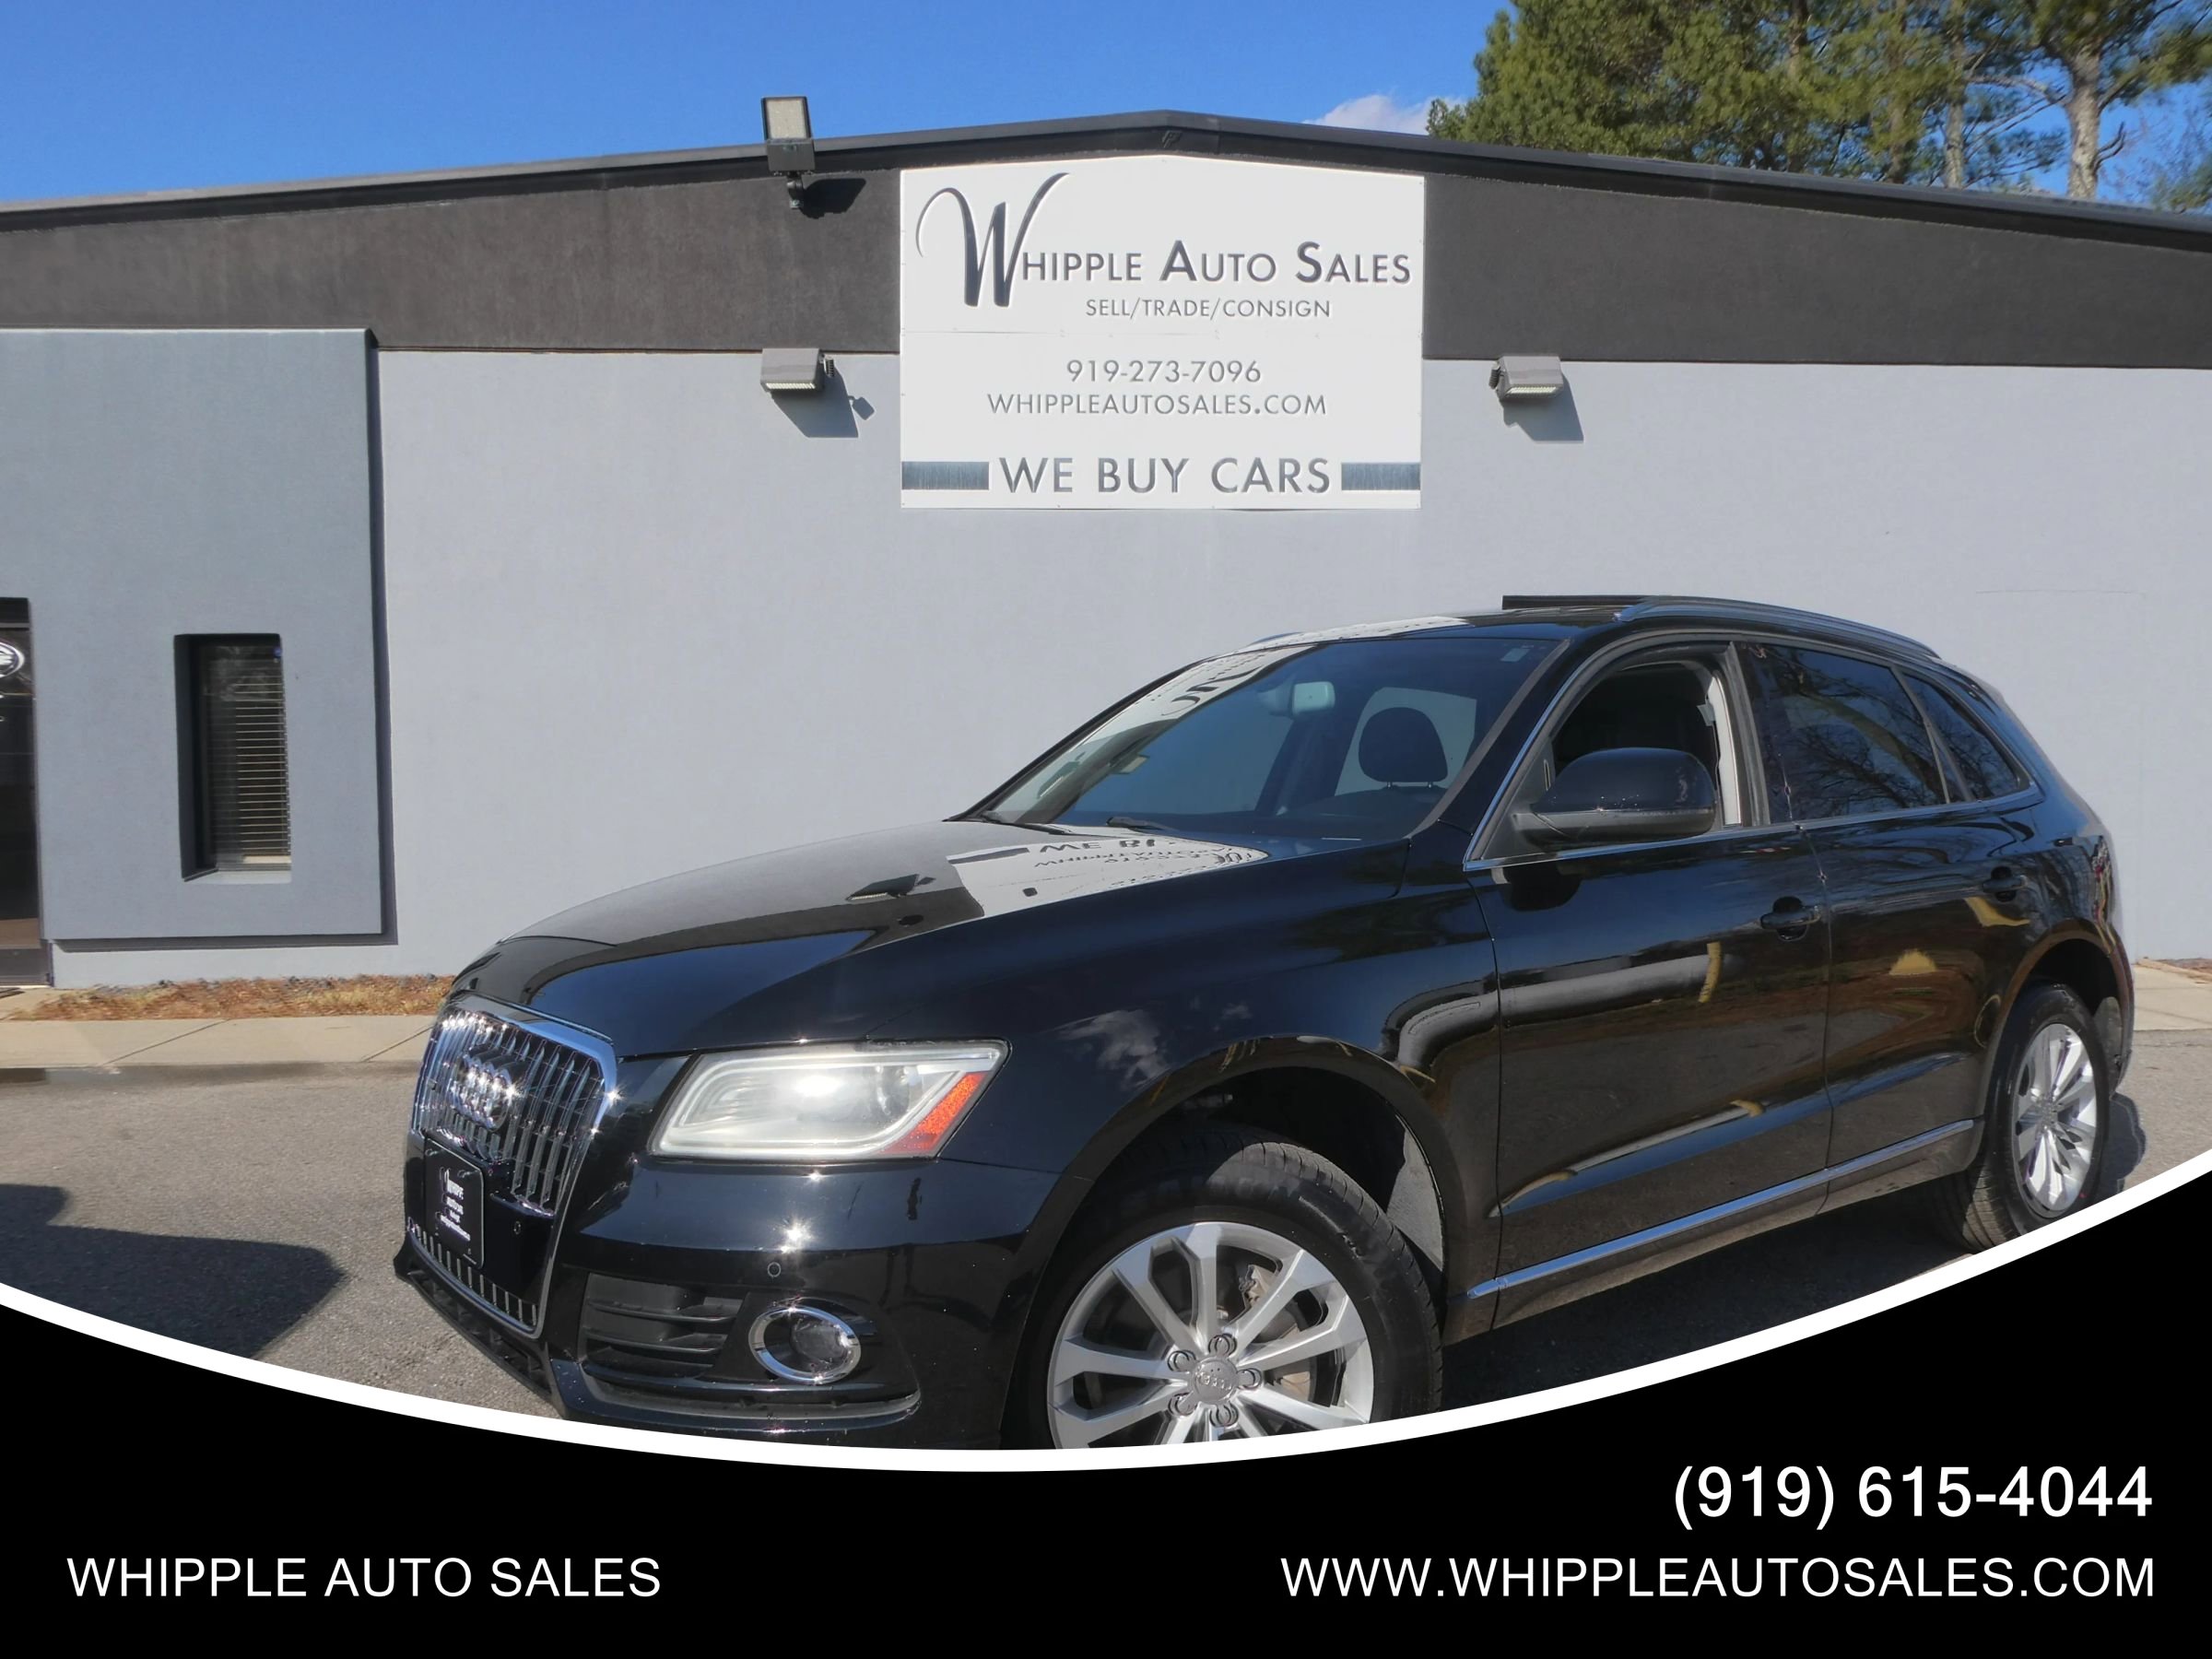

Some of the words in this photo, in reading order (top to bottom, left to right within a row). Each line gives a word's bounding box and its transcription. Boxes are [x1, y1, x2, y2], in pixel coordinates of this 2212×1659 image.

[1159, 240, 1277, 283] AUTO
[1296, 241, 1411, 284] SALES
[1086, 297, 1331, 321] SELL/TRADE/CONSIGN
[1066, 359, 1261, 383] 919-273-7096
[987, 393, 1327, 415] WHIPPLEAUTOSALES.COM
[999, 456, 1074, 494] WE
[1098, 457, 1190, 494] BUY
[1210, 456, 1331, 494] CARS
